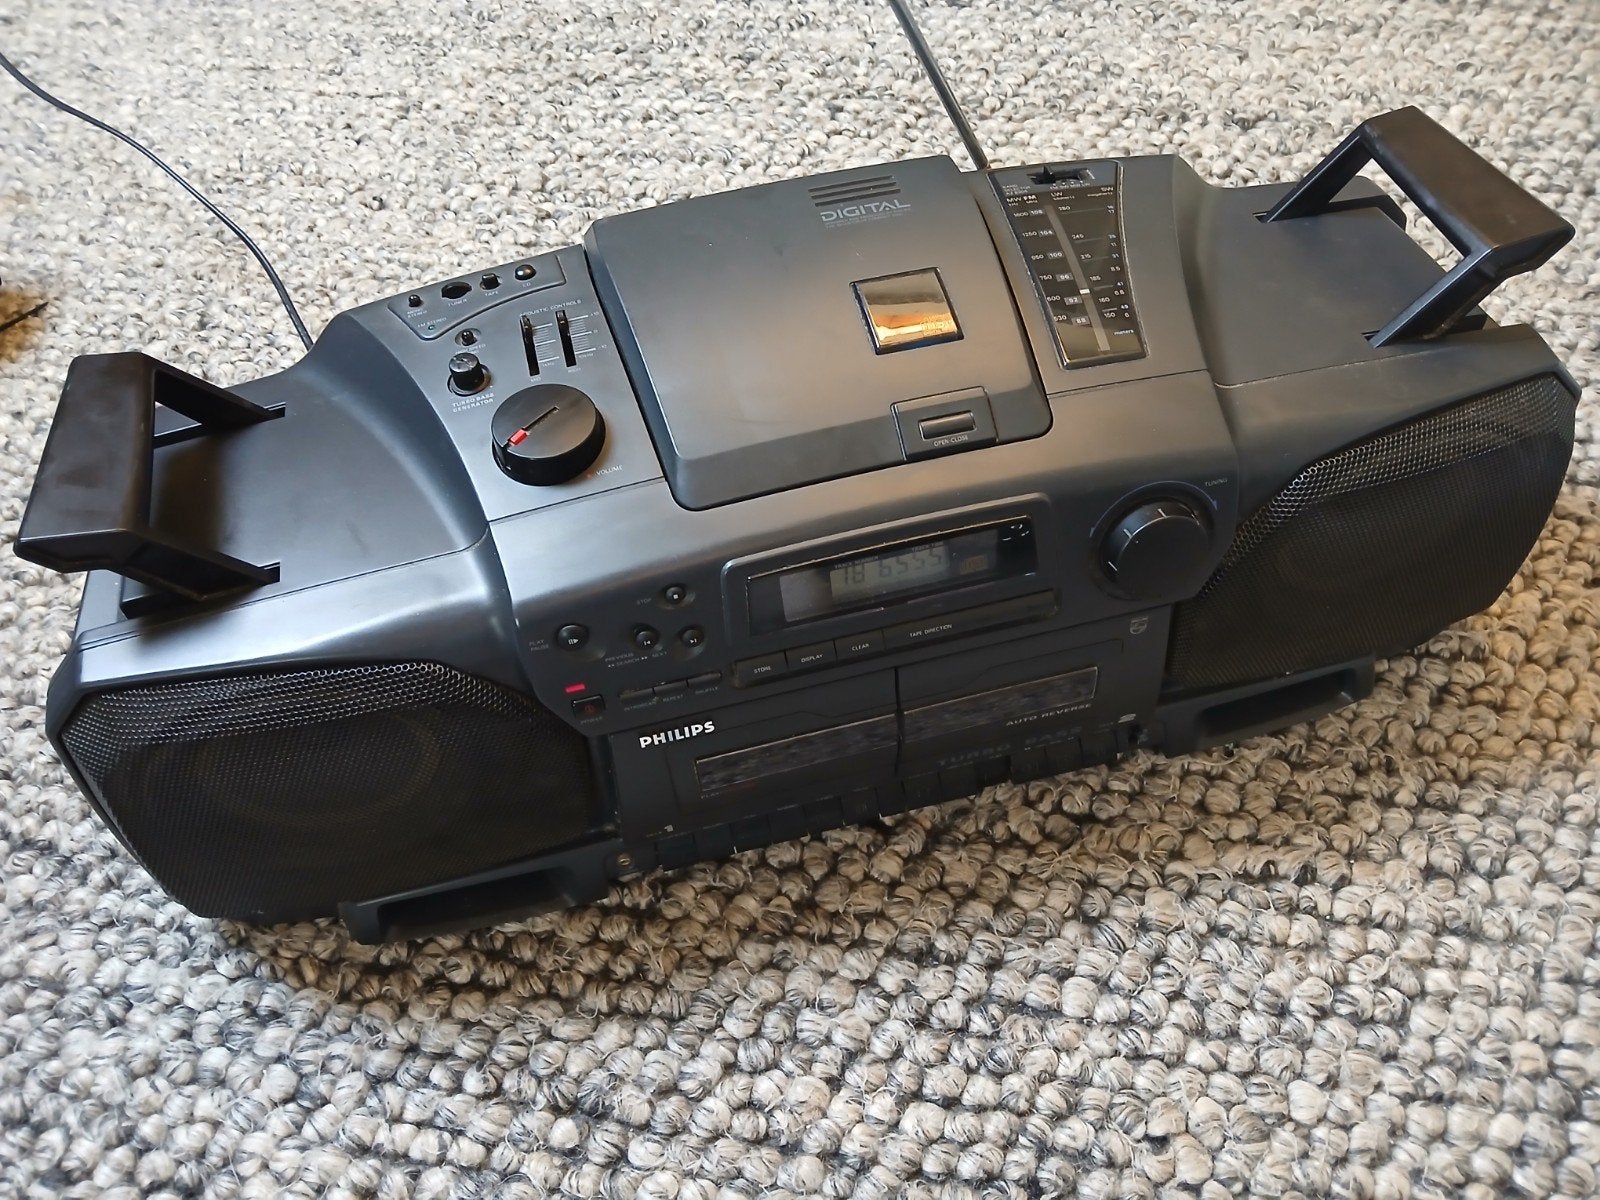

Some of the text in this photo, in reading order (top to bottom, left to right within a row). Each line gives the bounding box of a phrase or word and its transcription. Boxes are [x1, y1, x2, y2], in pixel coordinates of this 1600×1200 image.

[1006, 194, 1037, 204] MW FM
[820, 199, 911, 222] DIGITAL
[448, 298, 468, 307] TUNER
[550, 299, 582, 310] CONTROLS
[427, 317, 447, 326] STEREO
[452, 393, 494, 407] TURBO BASS
[453, 398, 493, 413] GENERATOR
[596, 464, 623, 475] VOLUME
[1205, 478, 1228, 488] TUNING
[637, 597, 652, 605] STOP
[909, 624, 953, 639] TAPE DIRECTION
[529, 638, 545, 647] PLAY
[851, 643, 870, 652] CLEAR
[616, 657, 640, 667] SEARCH
[801, 653, 824, 664] DISPLAY
[753, 665, 772, 674] STORE
[1006, 703, 1092, 726] AUTO REVERSE
[639, 720, 715, 748] PHILIPS
[937, 743, 1011, 766] TURBO
